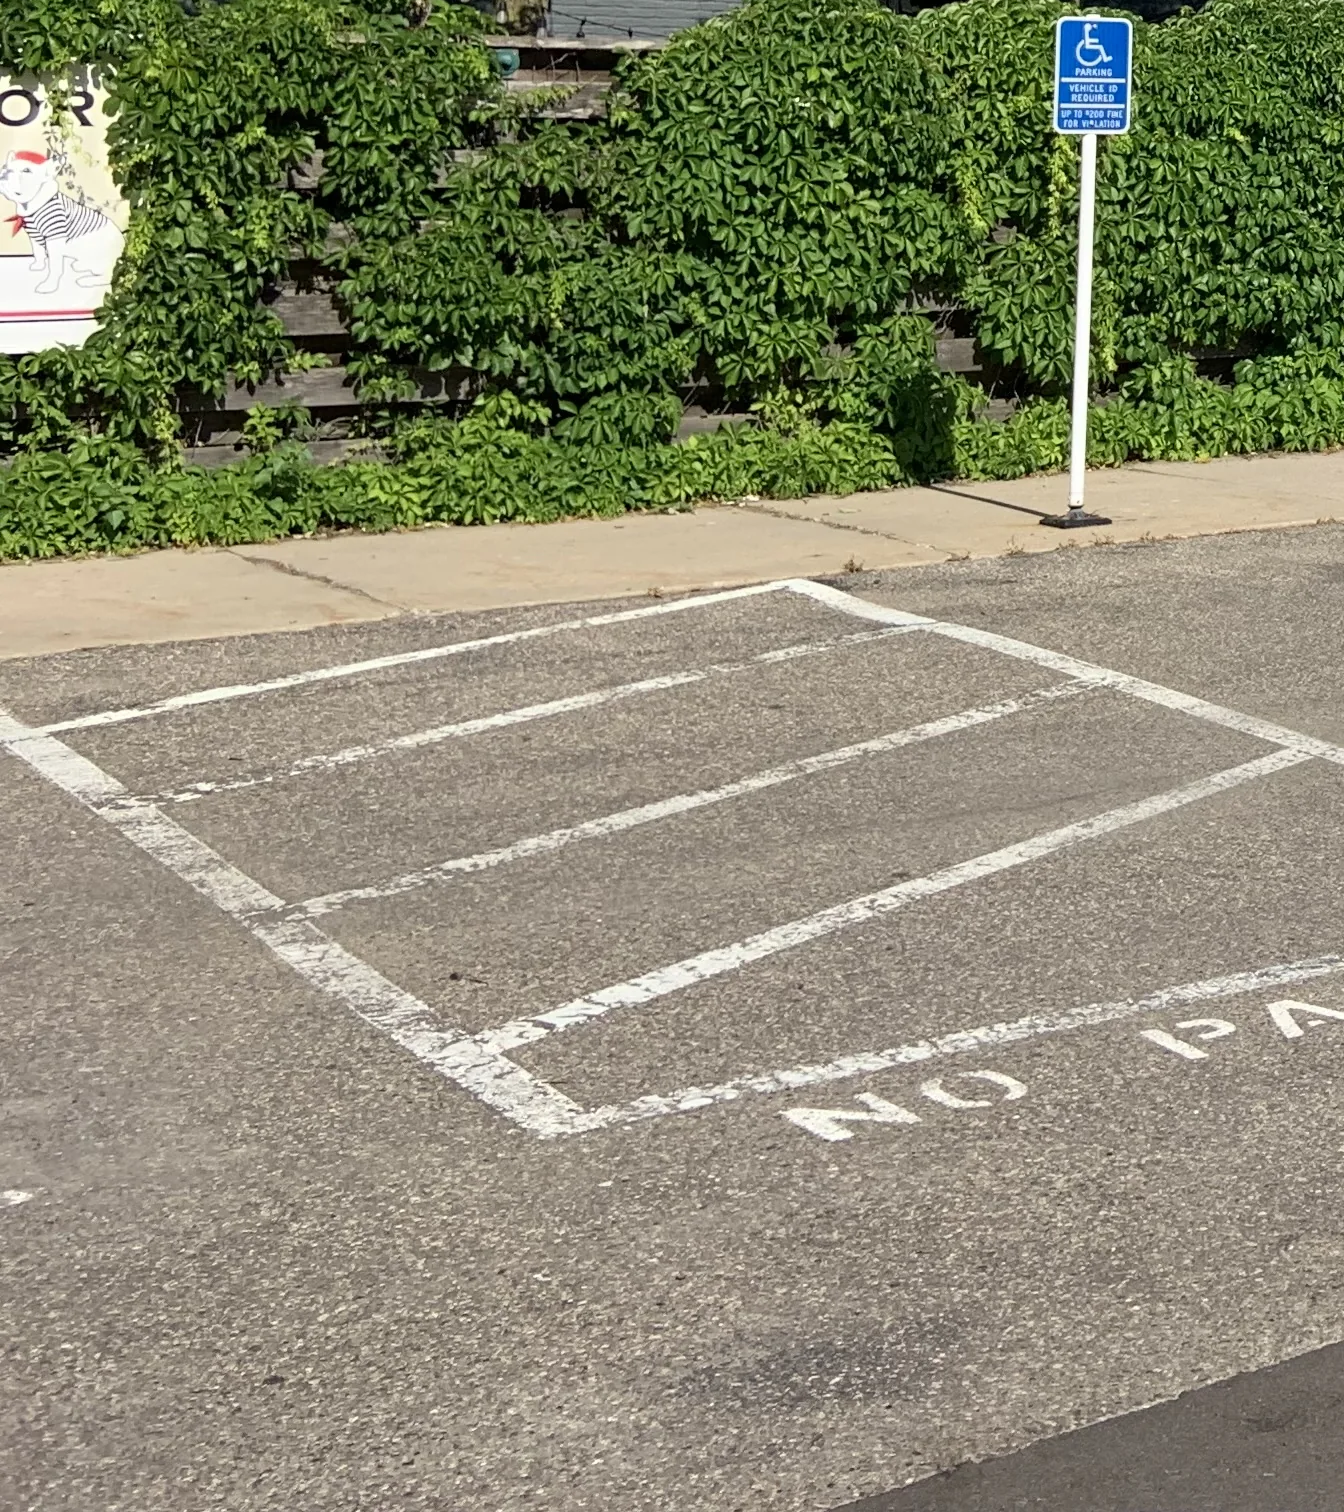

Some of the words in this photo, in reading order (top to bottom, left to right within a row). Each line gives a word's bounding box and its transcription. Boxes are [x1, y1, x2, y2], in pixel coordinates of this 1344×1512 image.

[1075, 67, 1113, 76] PARKING
[1069, 84, 1105, 93] VEHICLE
[1109, 84, 1118, 93] ID
[1071, 94, 1115, 102] REQUIRED
[1061, 110, 1072, 118] UP
[1074, 110, 1083, 118] TO
[1107, 110, 1123, 119] FINE
[1063, 119, 1079, 128] FOR
[777, 1070, 1029, 1143] NO
